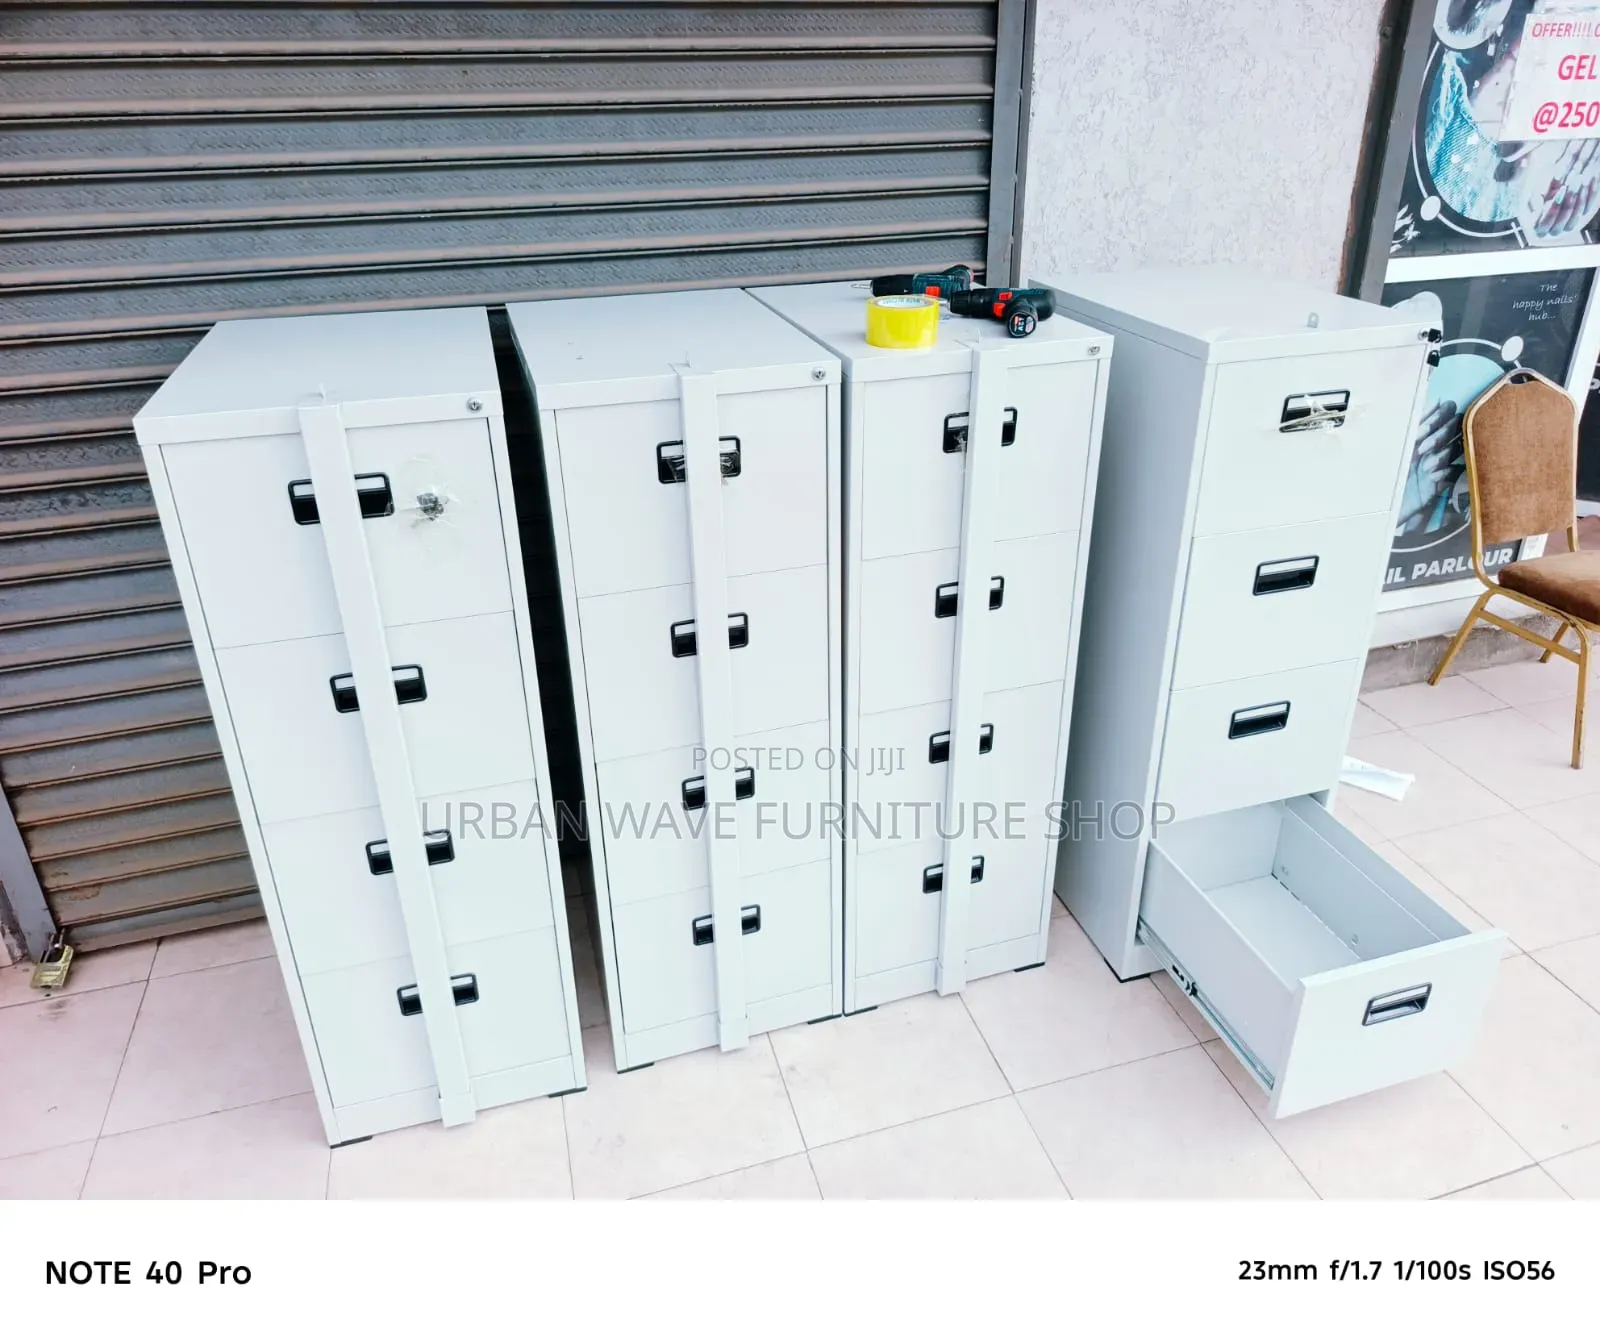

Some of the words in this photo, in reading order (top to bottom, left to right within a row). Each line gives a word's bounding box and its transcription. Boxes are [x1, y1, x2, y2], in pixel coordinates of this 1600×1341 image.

[1558, 54, 1597, 80] GEL
[1533, 101, 1600, 134] @250
[1539, 283, 1558, 292] The
[1512, 299, 1544, 311] happy
[1384, 566, 1406, 584] IL
